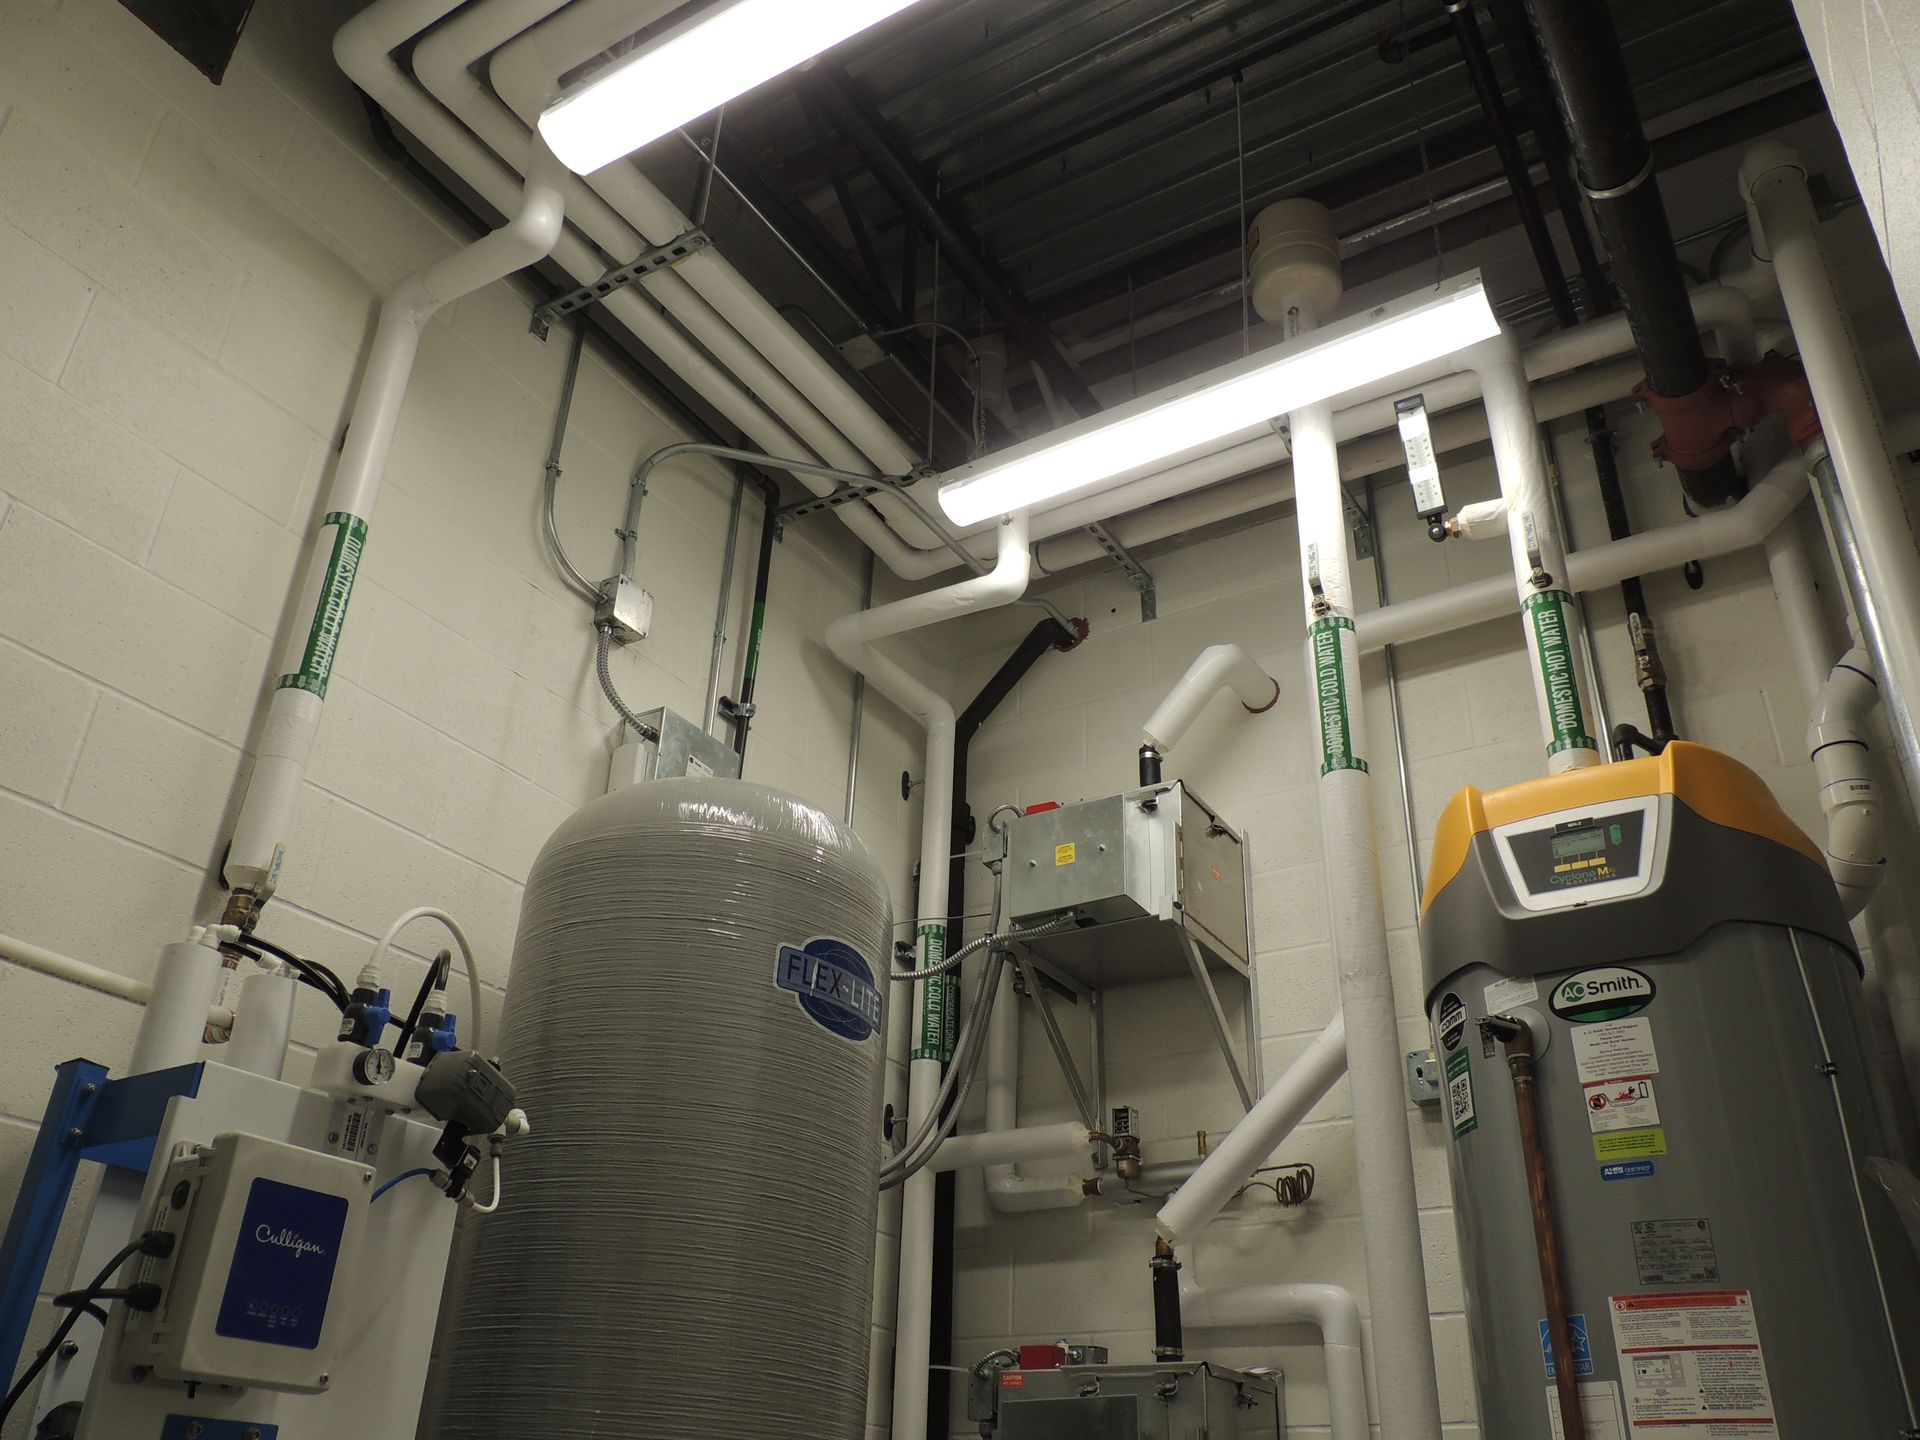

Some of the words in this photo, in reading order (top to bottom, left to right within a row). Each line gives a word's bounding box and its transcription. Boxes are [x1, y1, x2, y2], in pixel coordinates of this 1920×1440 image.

[1538, 608, 1563, 646] WATER
[1316, 630, 1336, 664] WATER
[1547, 649, 1568, 674] HOT
[1320, 664, 1339, 699] COLD
[1550, 672, 1578, 731] DOMESTIC
[1323, 698, 1345, 755] DOMESTIC
[1550, 869, 1596, 885] Cyclone
[927, 938, 943, 985] DOMEIC
[787, 954, 880, 1025] FLEX-LITE
[927, 986, 942, 1013] COLD
[945, 985, 955, 1028] CONDENSATE
[927, 1013, 941, 1045] WATER
[944, 1029, 954, 1050] DRAIN
[255, 1224, 325, 1258] Culligan
